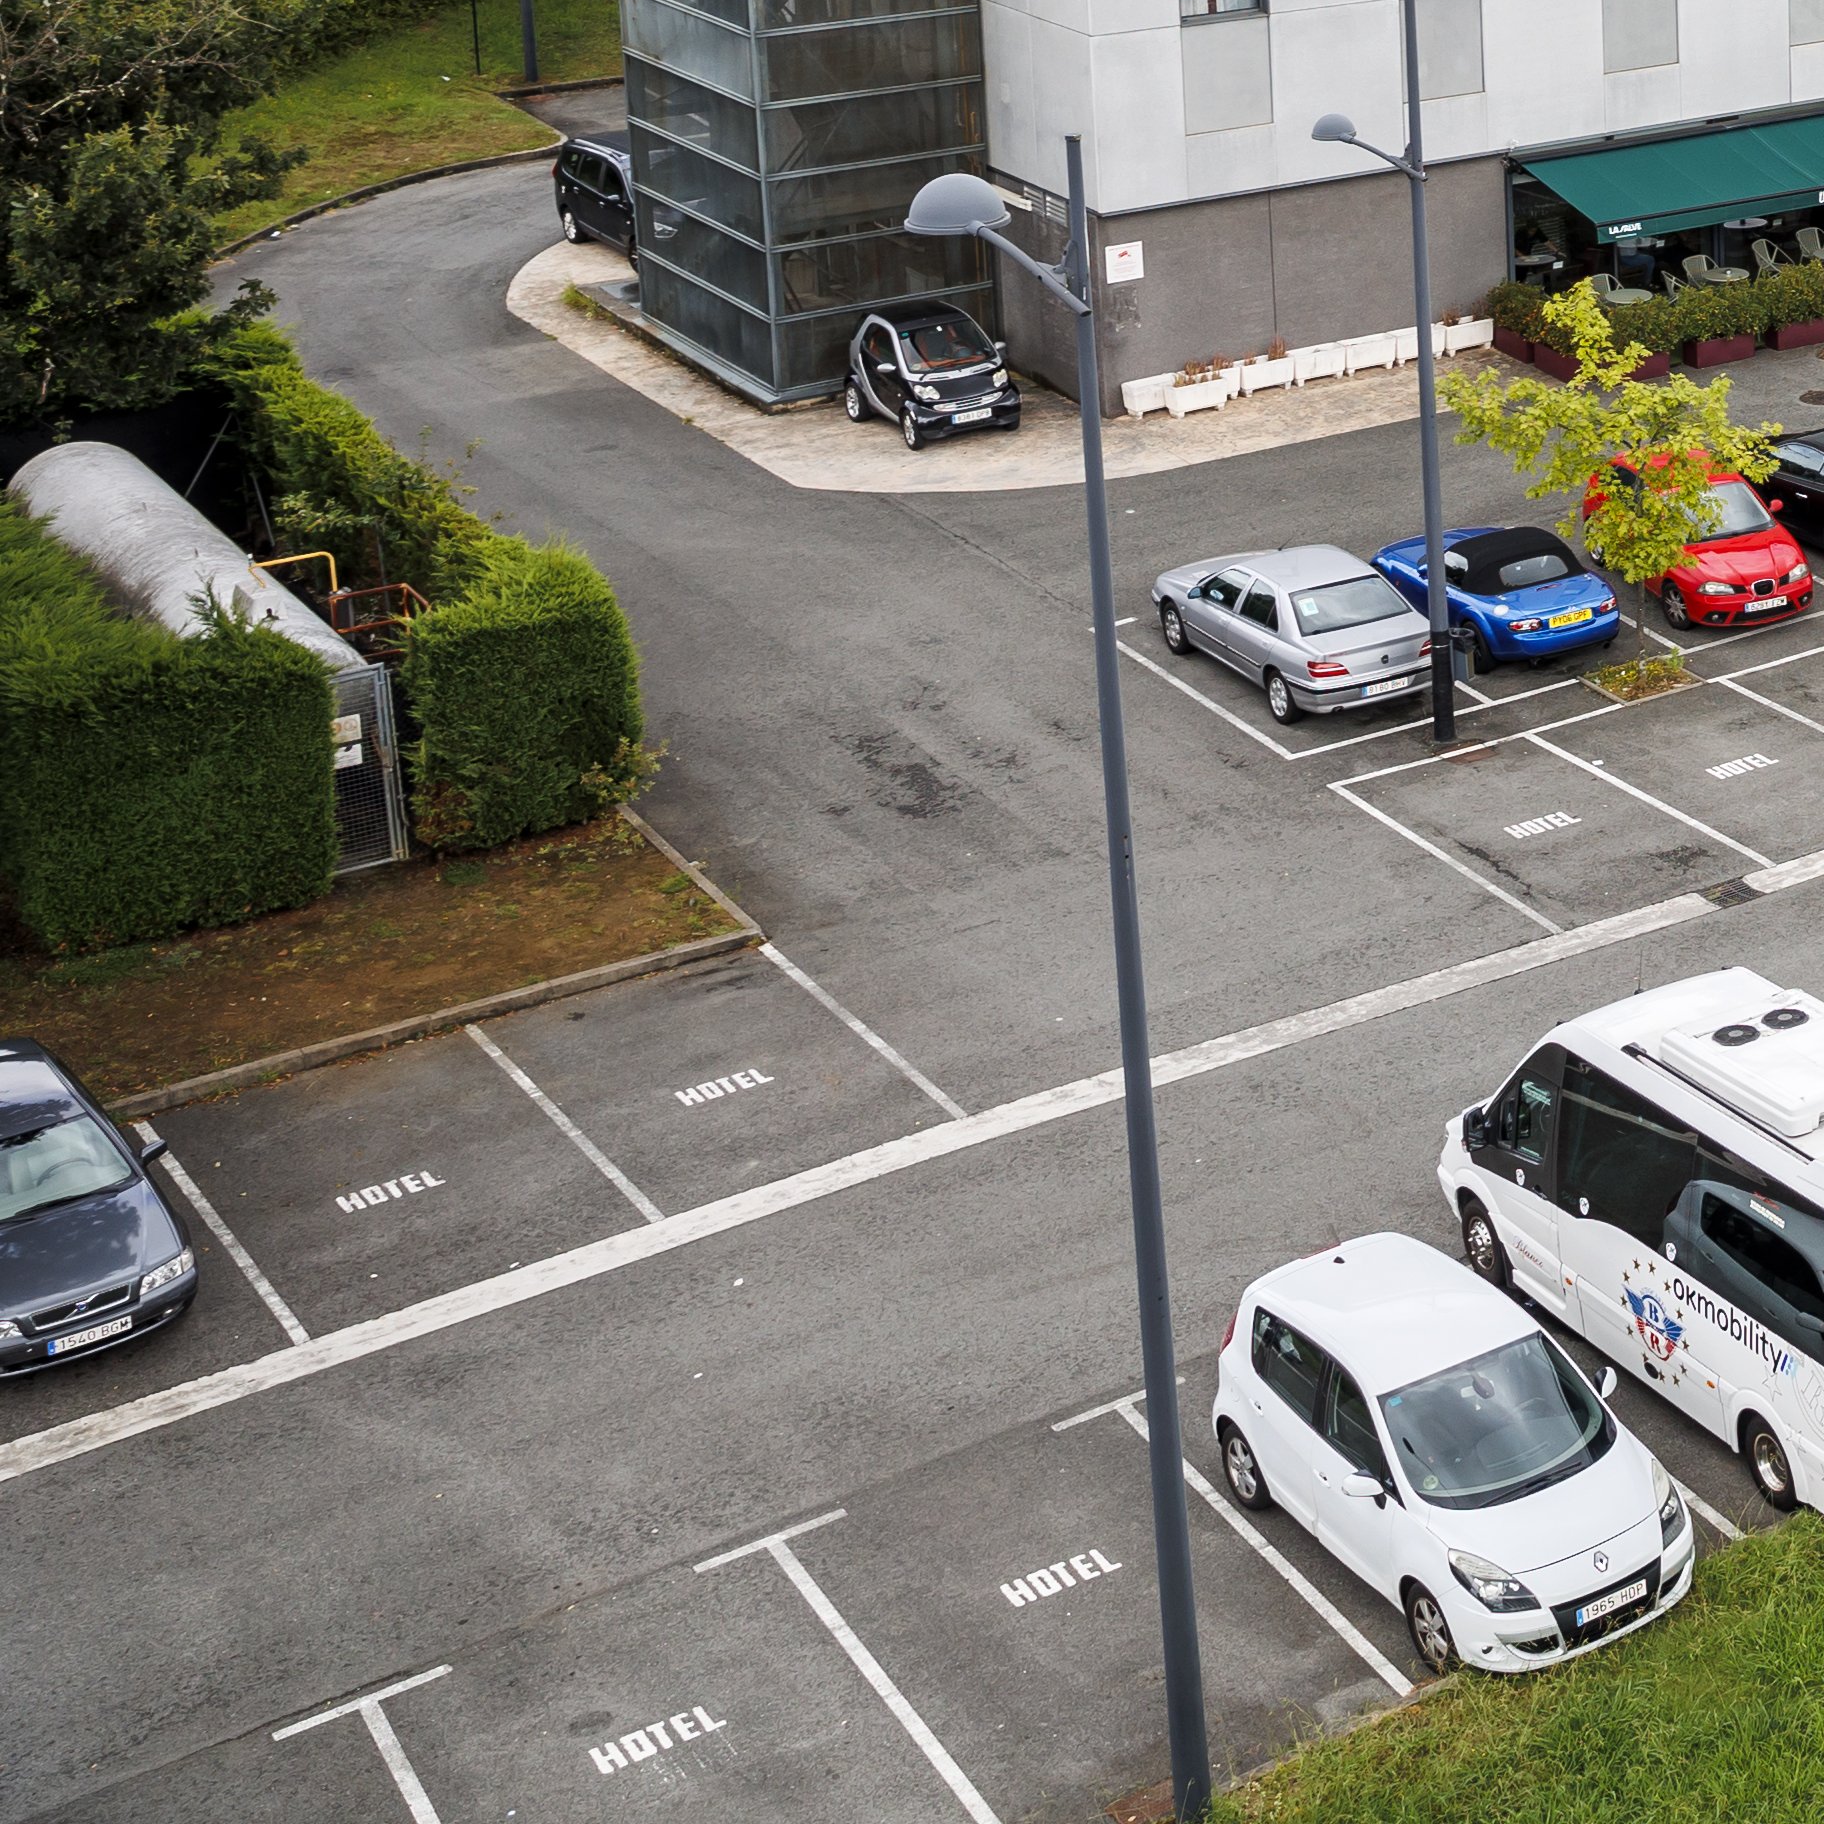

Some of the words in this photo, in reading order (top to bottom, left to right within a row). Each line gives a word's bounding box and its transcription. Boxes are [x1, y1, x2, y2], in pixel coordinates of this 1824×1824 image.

[1705, 753, 1779, 780] HOTEL
[1503, 811, 1582, 839] HOTEL
[674, 1068, 775, 1106] HOTEL
[335, 1170, 446, 1213] HOTEL
[57, 1329, 96, 1355] 1540
[101, 1318, 131, 1336] BGM
[1673, 1278, 1782, 1374] okmobility
[999, 1549, 1123, 1607] HOTEL
[1584, 1600, 1615, 1620] 1965
[1620, 1582, 1644, 1602] HDP
[588, 1705, 727, 1775] HOTEL
